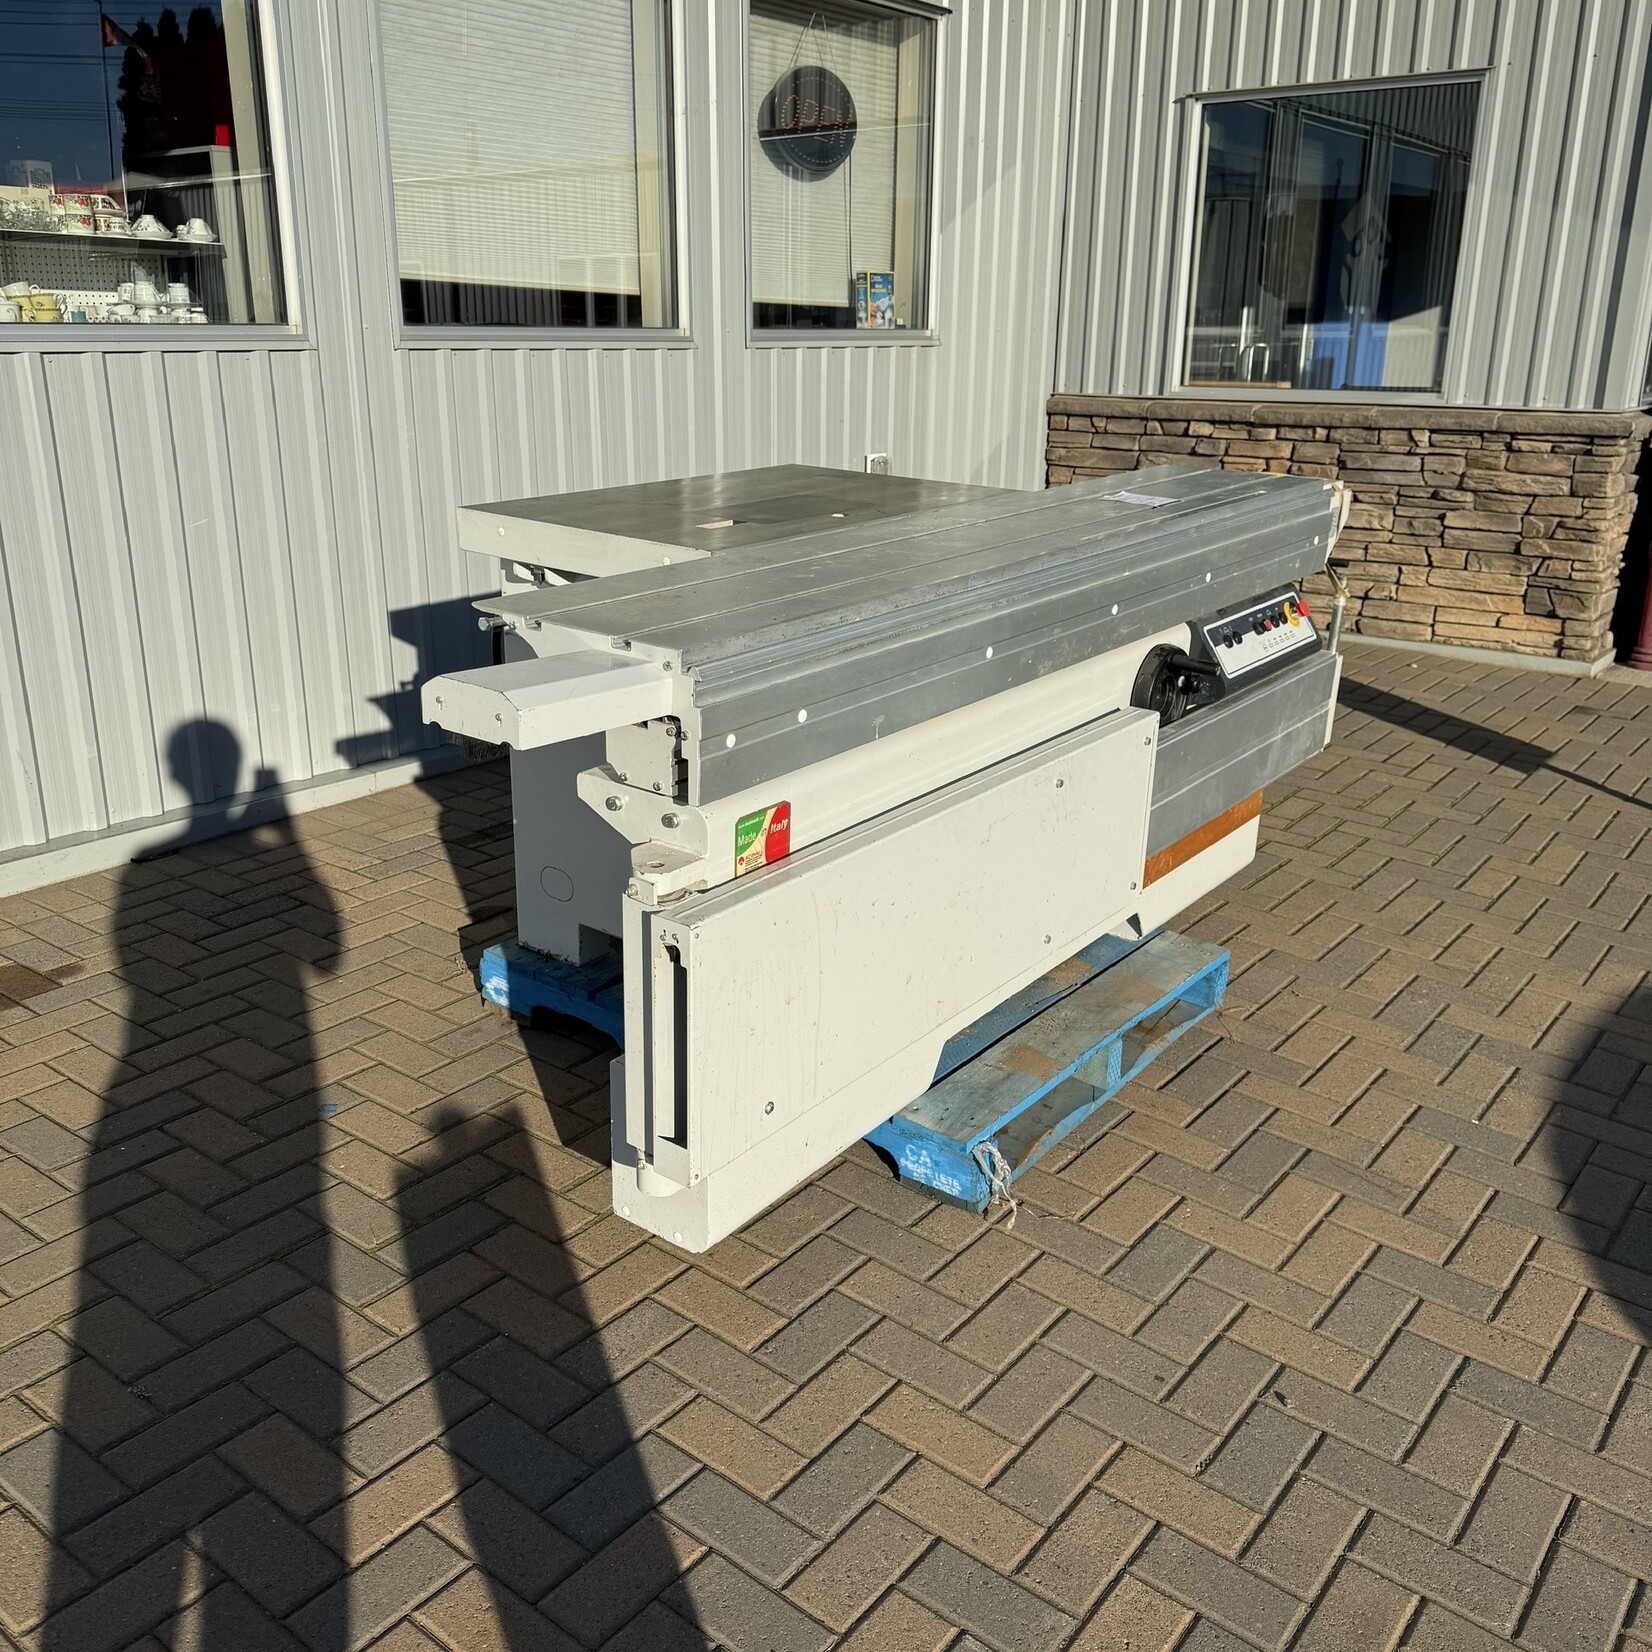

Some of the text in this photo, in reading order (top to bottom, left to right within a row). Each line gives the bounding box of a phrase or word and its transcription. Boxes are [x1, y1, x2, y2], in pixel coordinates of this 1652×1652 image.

[780, 94, 853, 148] OPEN
[737, 832, 757, 847] Made
[770, 818, 789, 834] Italy
